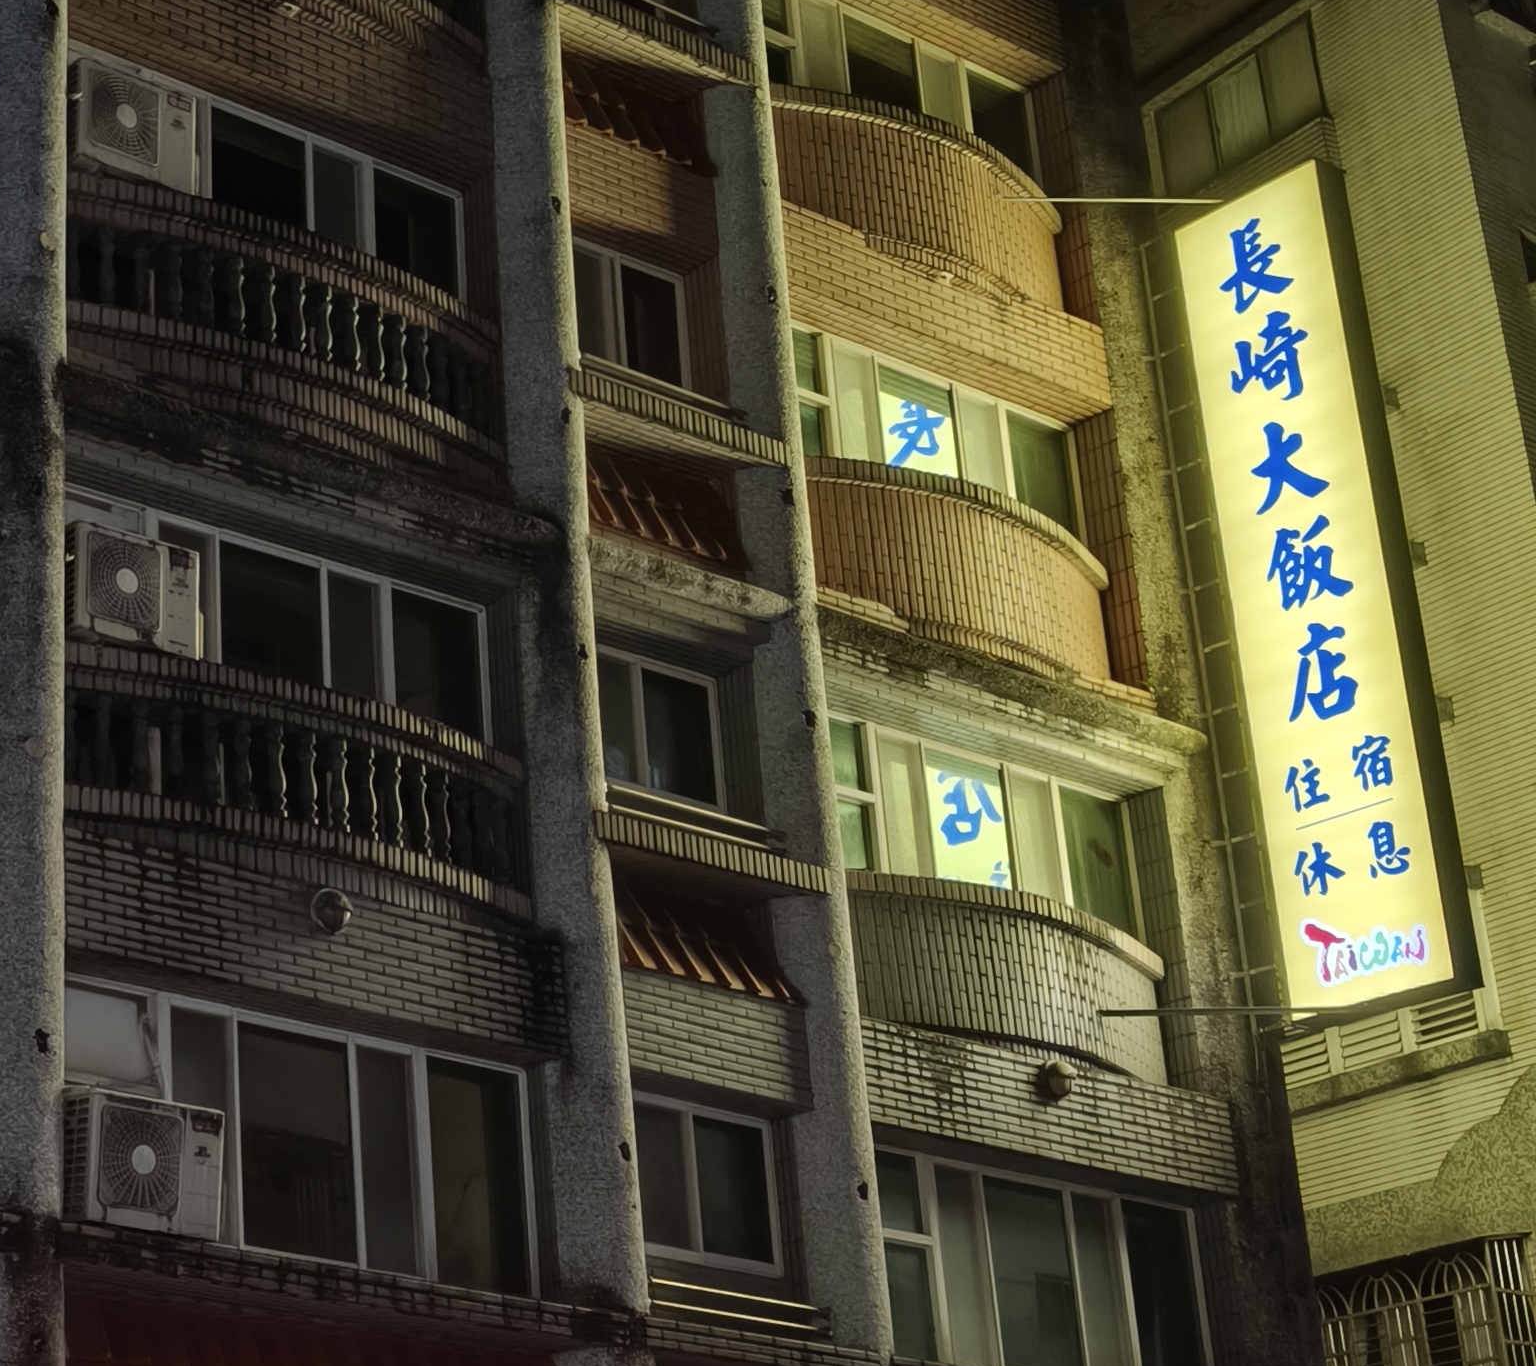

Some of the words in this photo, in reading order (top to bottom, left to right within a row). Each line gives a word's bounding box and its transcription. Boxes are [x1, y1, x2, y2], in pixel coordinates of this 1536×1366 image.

[1219, 217, 1359, 724] 長崎大飯店
